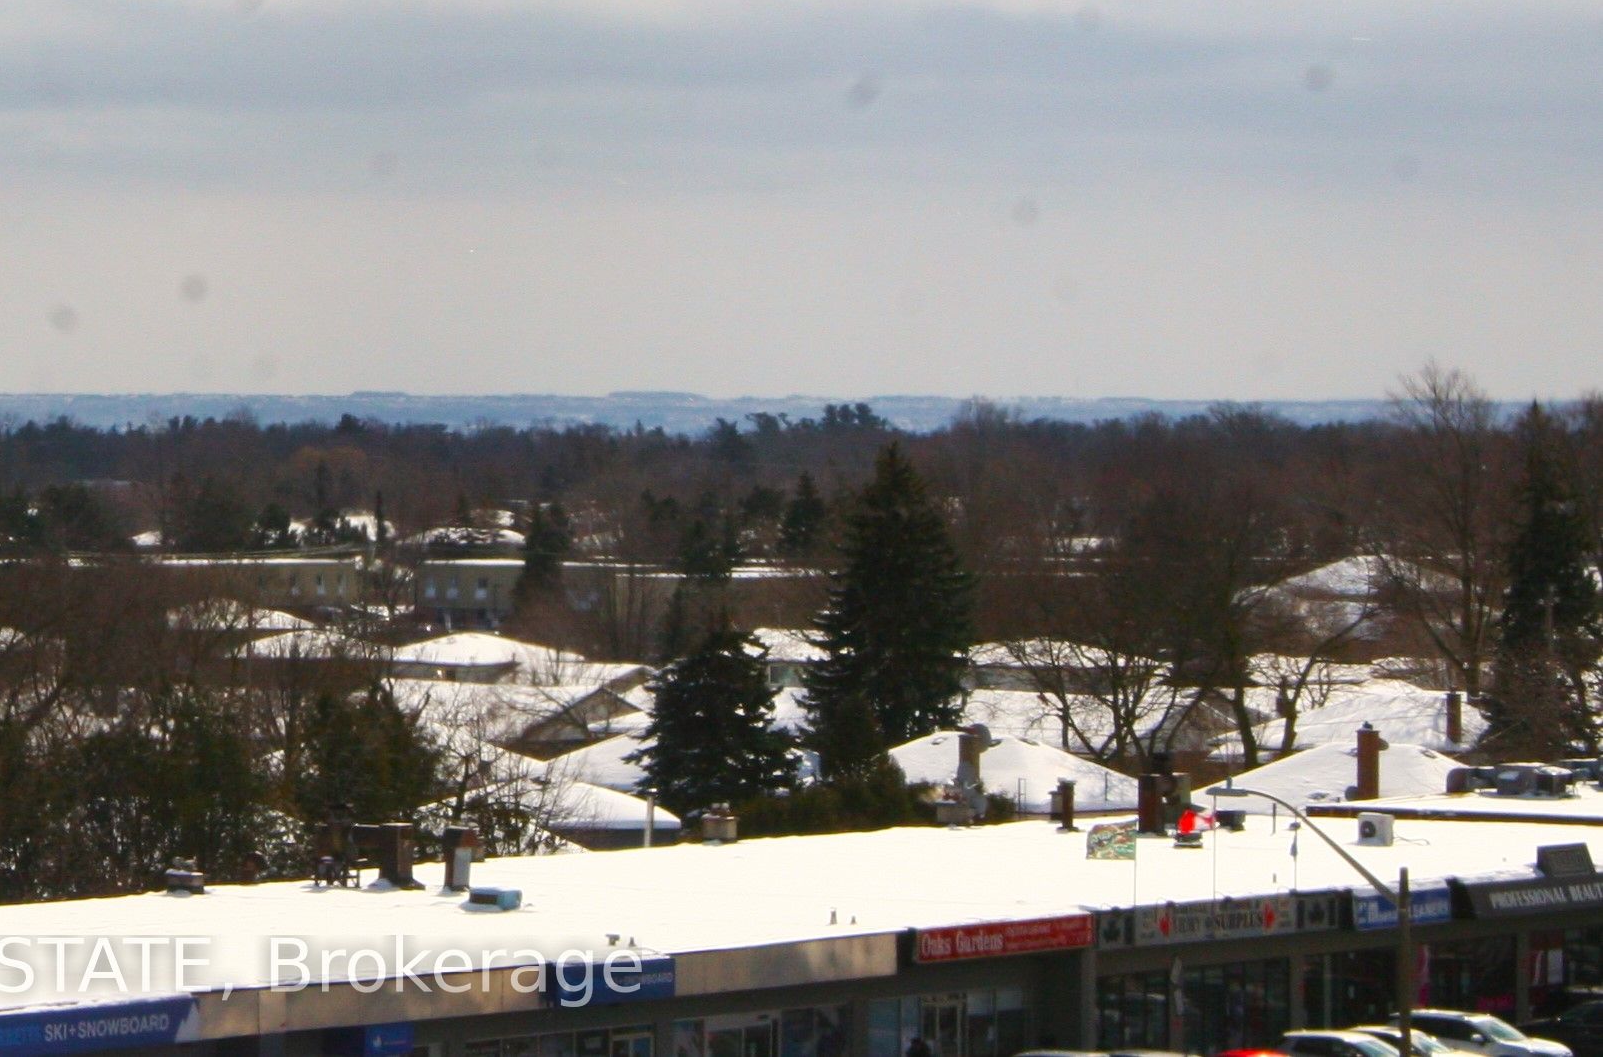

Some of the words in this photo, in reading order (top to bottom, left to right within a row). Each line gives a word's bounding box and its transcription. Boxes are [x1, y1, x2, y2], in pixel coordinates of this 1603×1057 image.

[1489, 886, 1567, 909] PROFESSIONAL
[921, 931, 951, 956] Oaks
[955, 928, 1004, 953] Gardens
